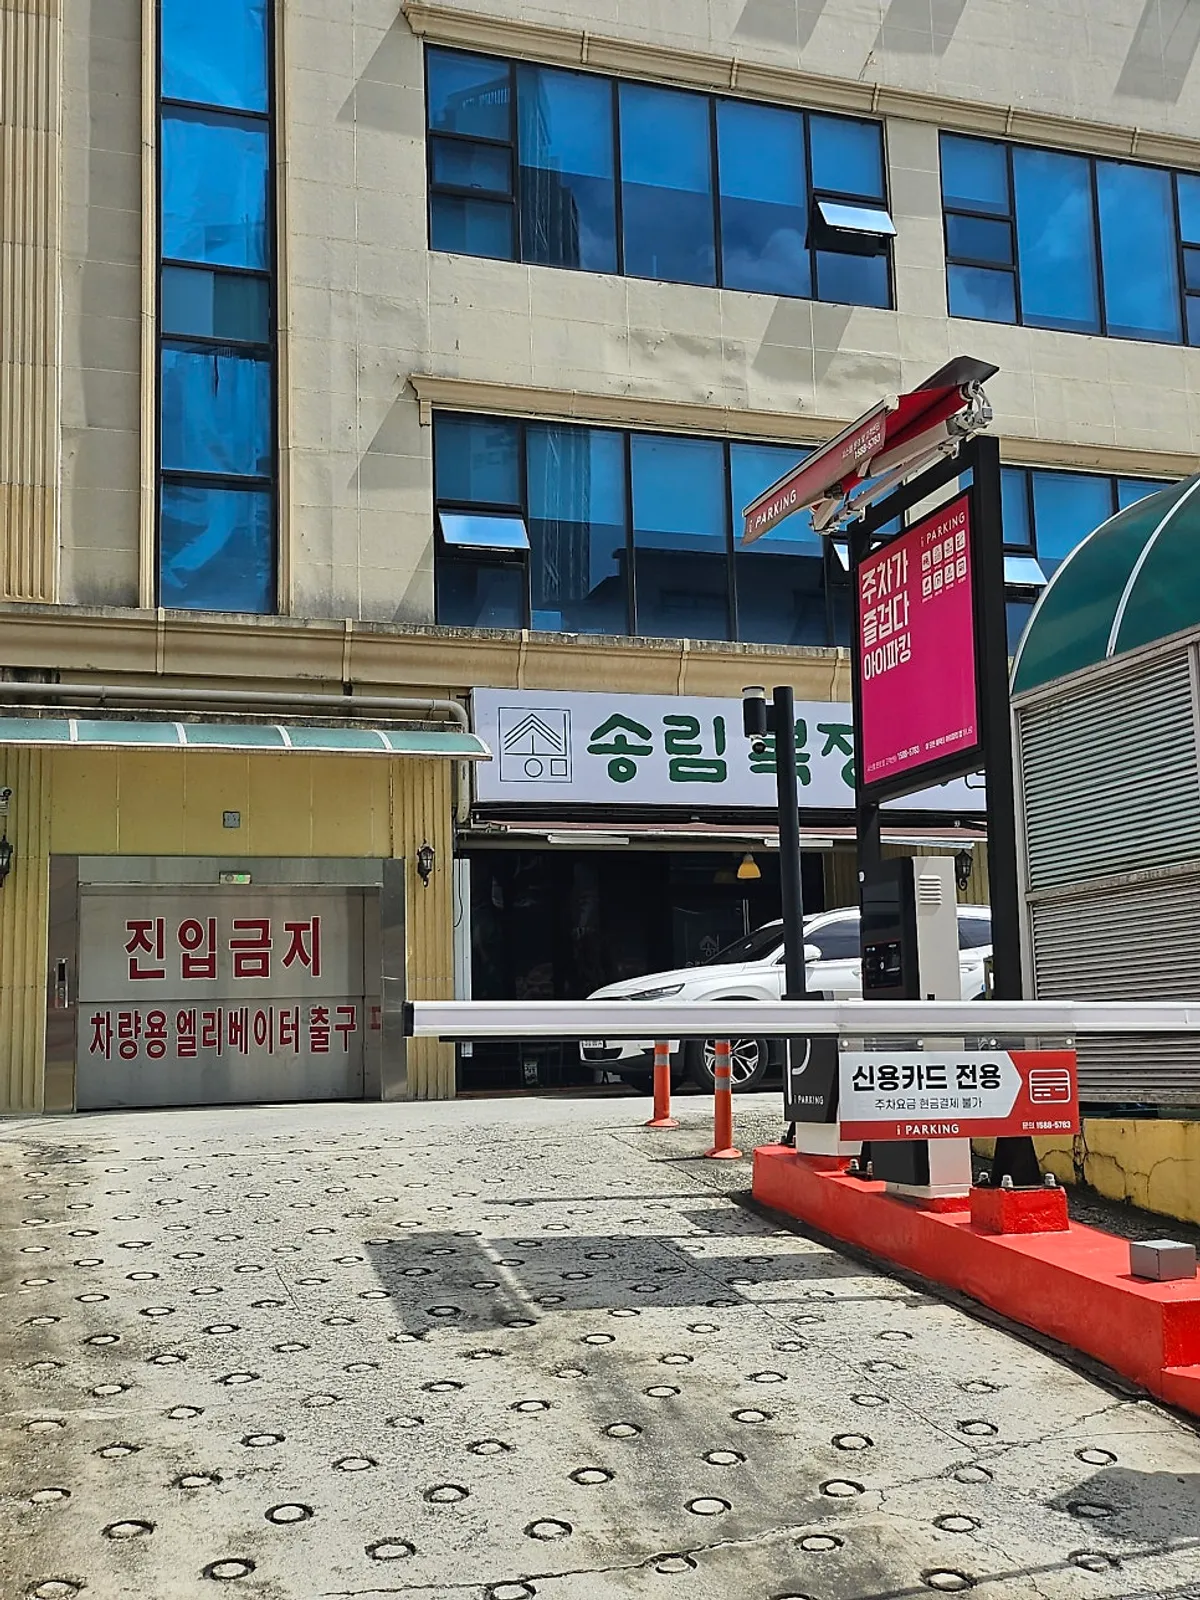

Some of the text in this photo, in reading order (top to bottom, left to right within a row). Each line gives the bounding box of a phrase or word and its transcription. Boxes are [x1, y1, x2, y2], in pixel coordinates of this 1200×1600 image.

[755, 489, 797, 528] PARKING
[926, 512, 965, 545] PARKING
[862, 548, 909, 605] 주차가
[863, 590, 910, 648] 즐겁다
[863, 632, 911, 681] 아이파킹
[587, 713, 727, 783] 송림
[124, 915, 322, 981] 진입금지
[89, 1005, 358, 1060] 차량용 엘리베이터 출구
[852, 1063, 1001, 1092] 신용카드 전용
[798, 1095, 824, 1105] PARKING
[874, 1096, 983, 1111] 주차요금 현금결제 불가
[905, 1123, 960, 1135] PARKING
[1036, 1120, 1071, 1129] 1588-5783
